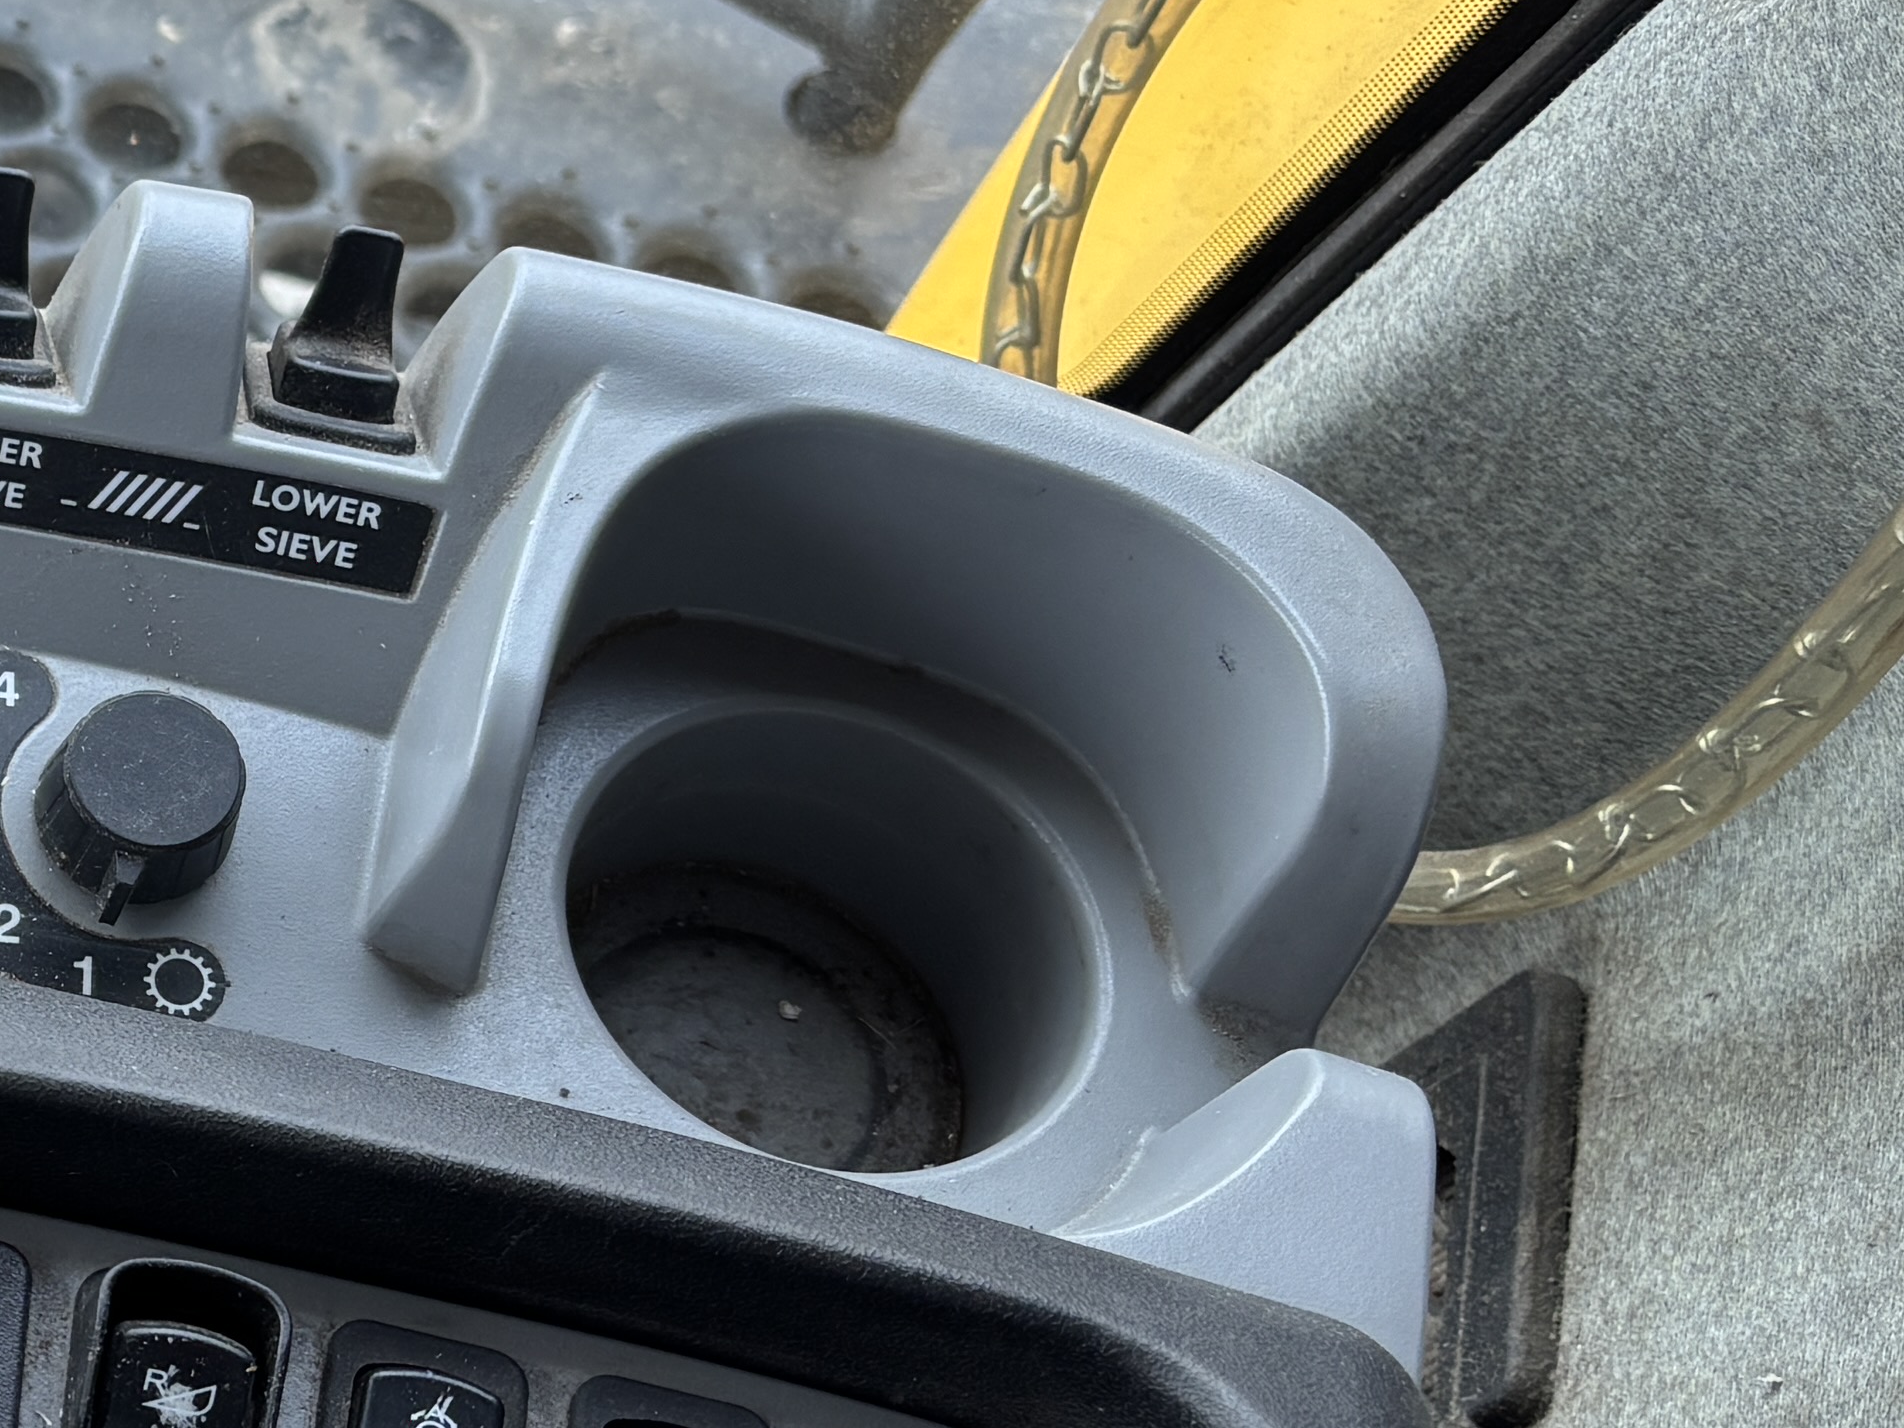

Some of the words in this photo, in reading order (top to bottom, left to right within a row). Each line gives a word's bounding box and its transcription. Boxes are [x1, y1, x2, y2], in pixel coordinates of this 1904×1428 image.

[252, 479, 382, 530] LOWER
[254, 526, 358, 569] SIEVE
[72, 955, 93, 996] 1
[143, 1368, 169, 1397] R
